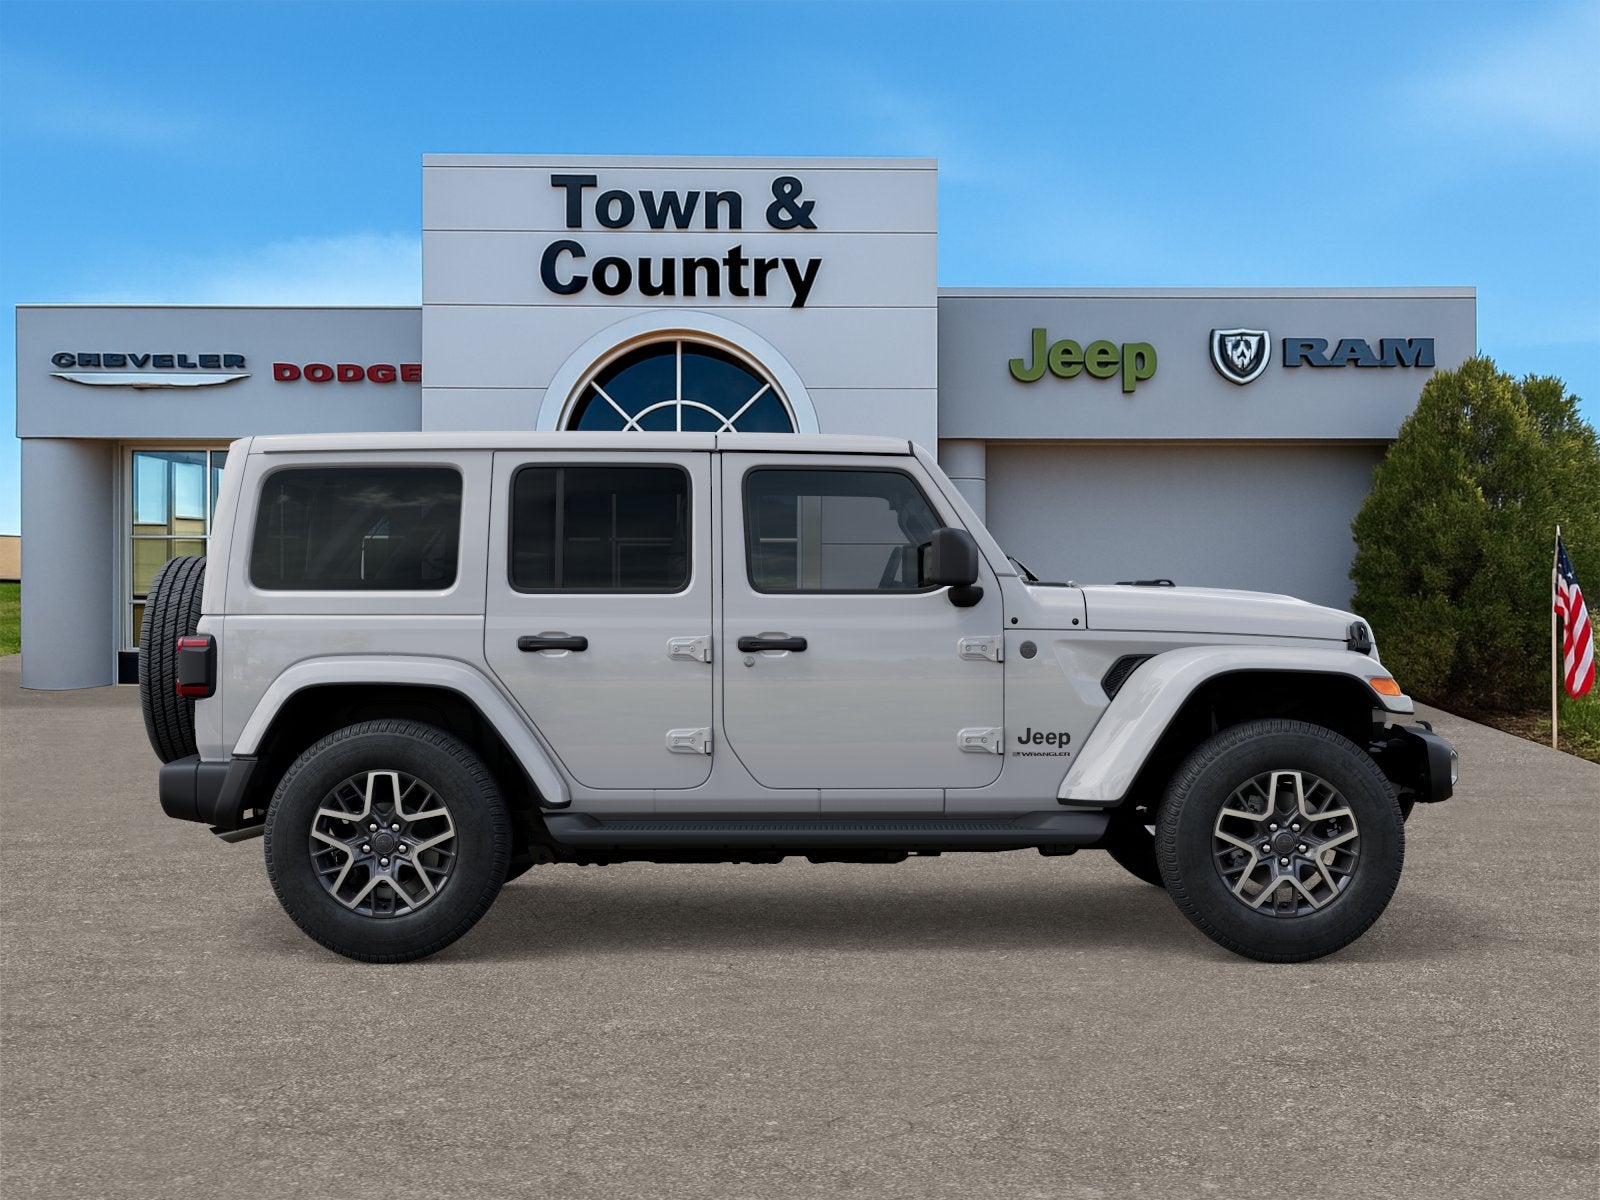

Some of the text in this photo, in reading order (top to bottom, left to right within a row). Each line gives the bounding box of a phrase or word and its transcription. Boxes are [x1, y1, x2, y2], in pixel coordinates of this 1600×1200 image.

[550, 174, 818, 230] Town &
[540, 239, 823, 308] Country
[272, 362, 422, 383] DODGE
[1009, 327, 1157, 393] Jeep
[1283, 337, 1435, 367] RAM
[1017, 727, 1071, 749] Jeep
